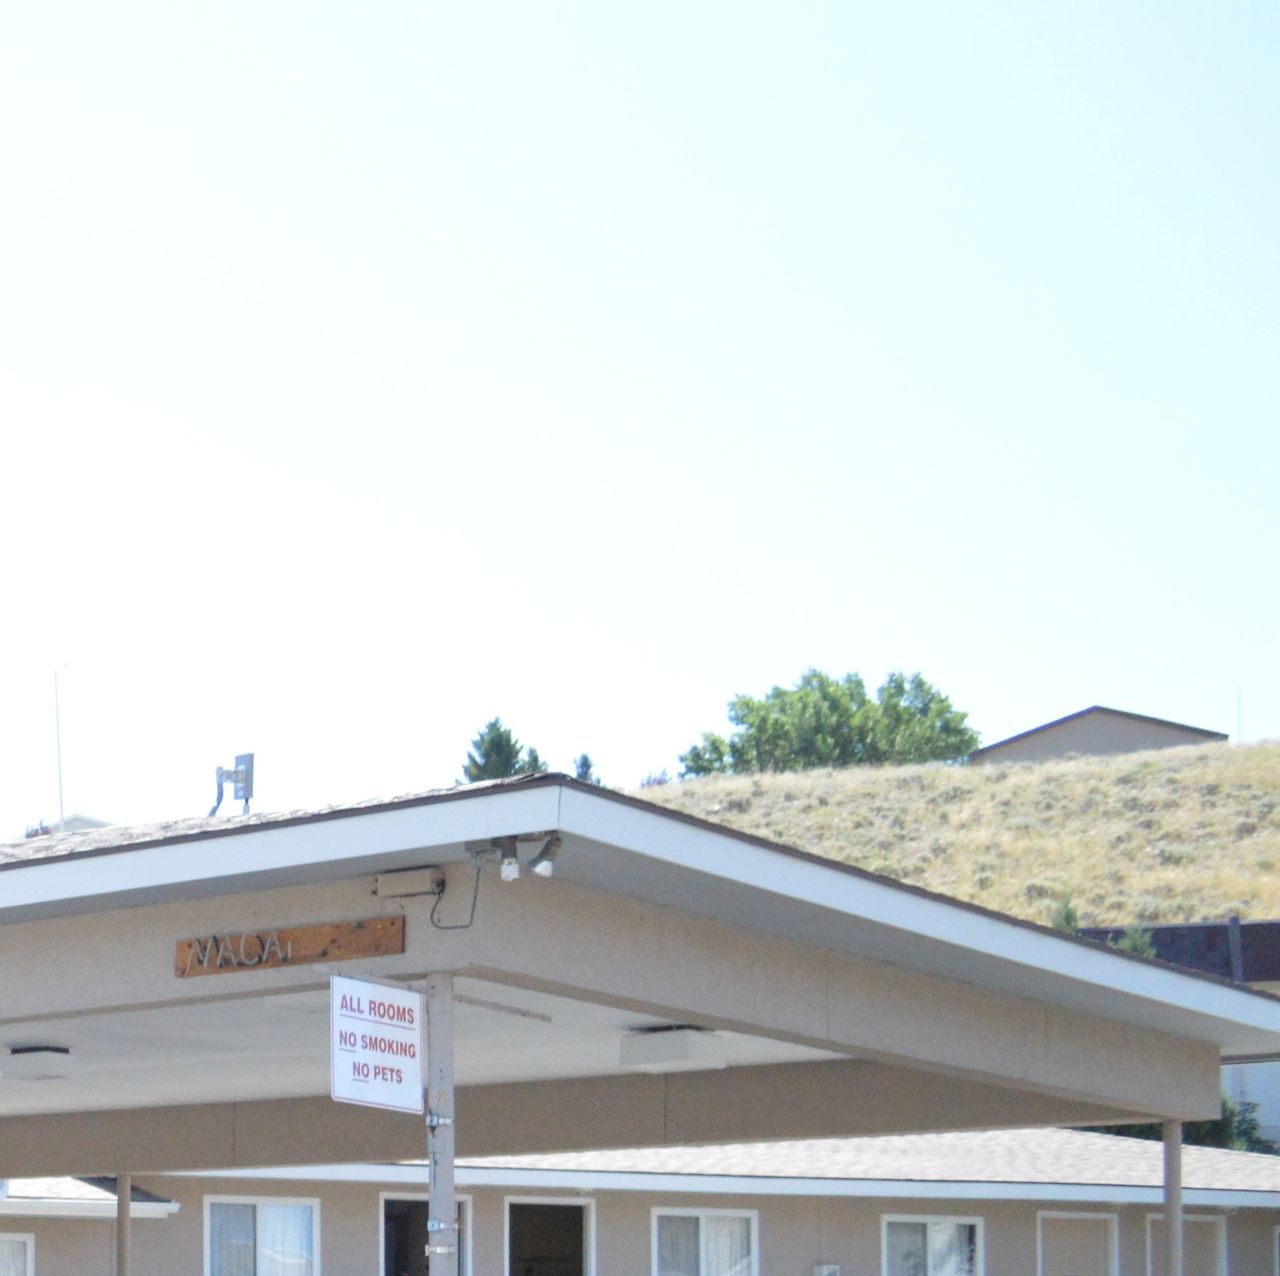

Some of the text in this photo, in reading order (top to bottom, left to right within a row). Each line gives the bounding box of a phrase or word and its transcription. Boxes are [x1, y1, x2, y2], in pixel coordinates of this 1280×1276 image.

[340, 993, 415, 1025] ALL ROOMS
[339, 1029, 416, 1059] NO SMOKING
[352, 1061, 403, 1085] NO PETS
